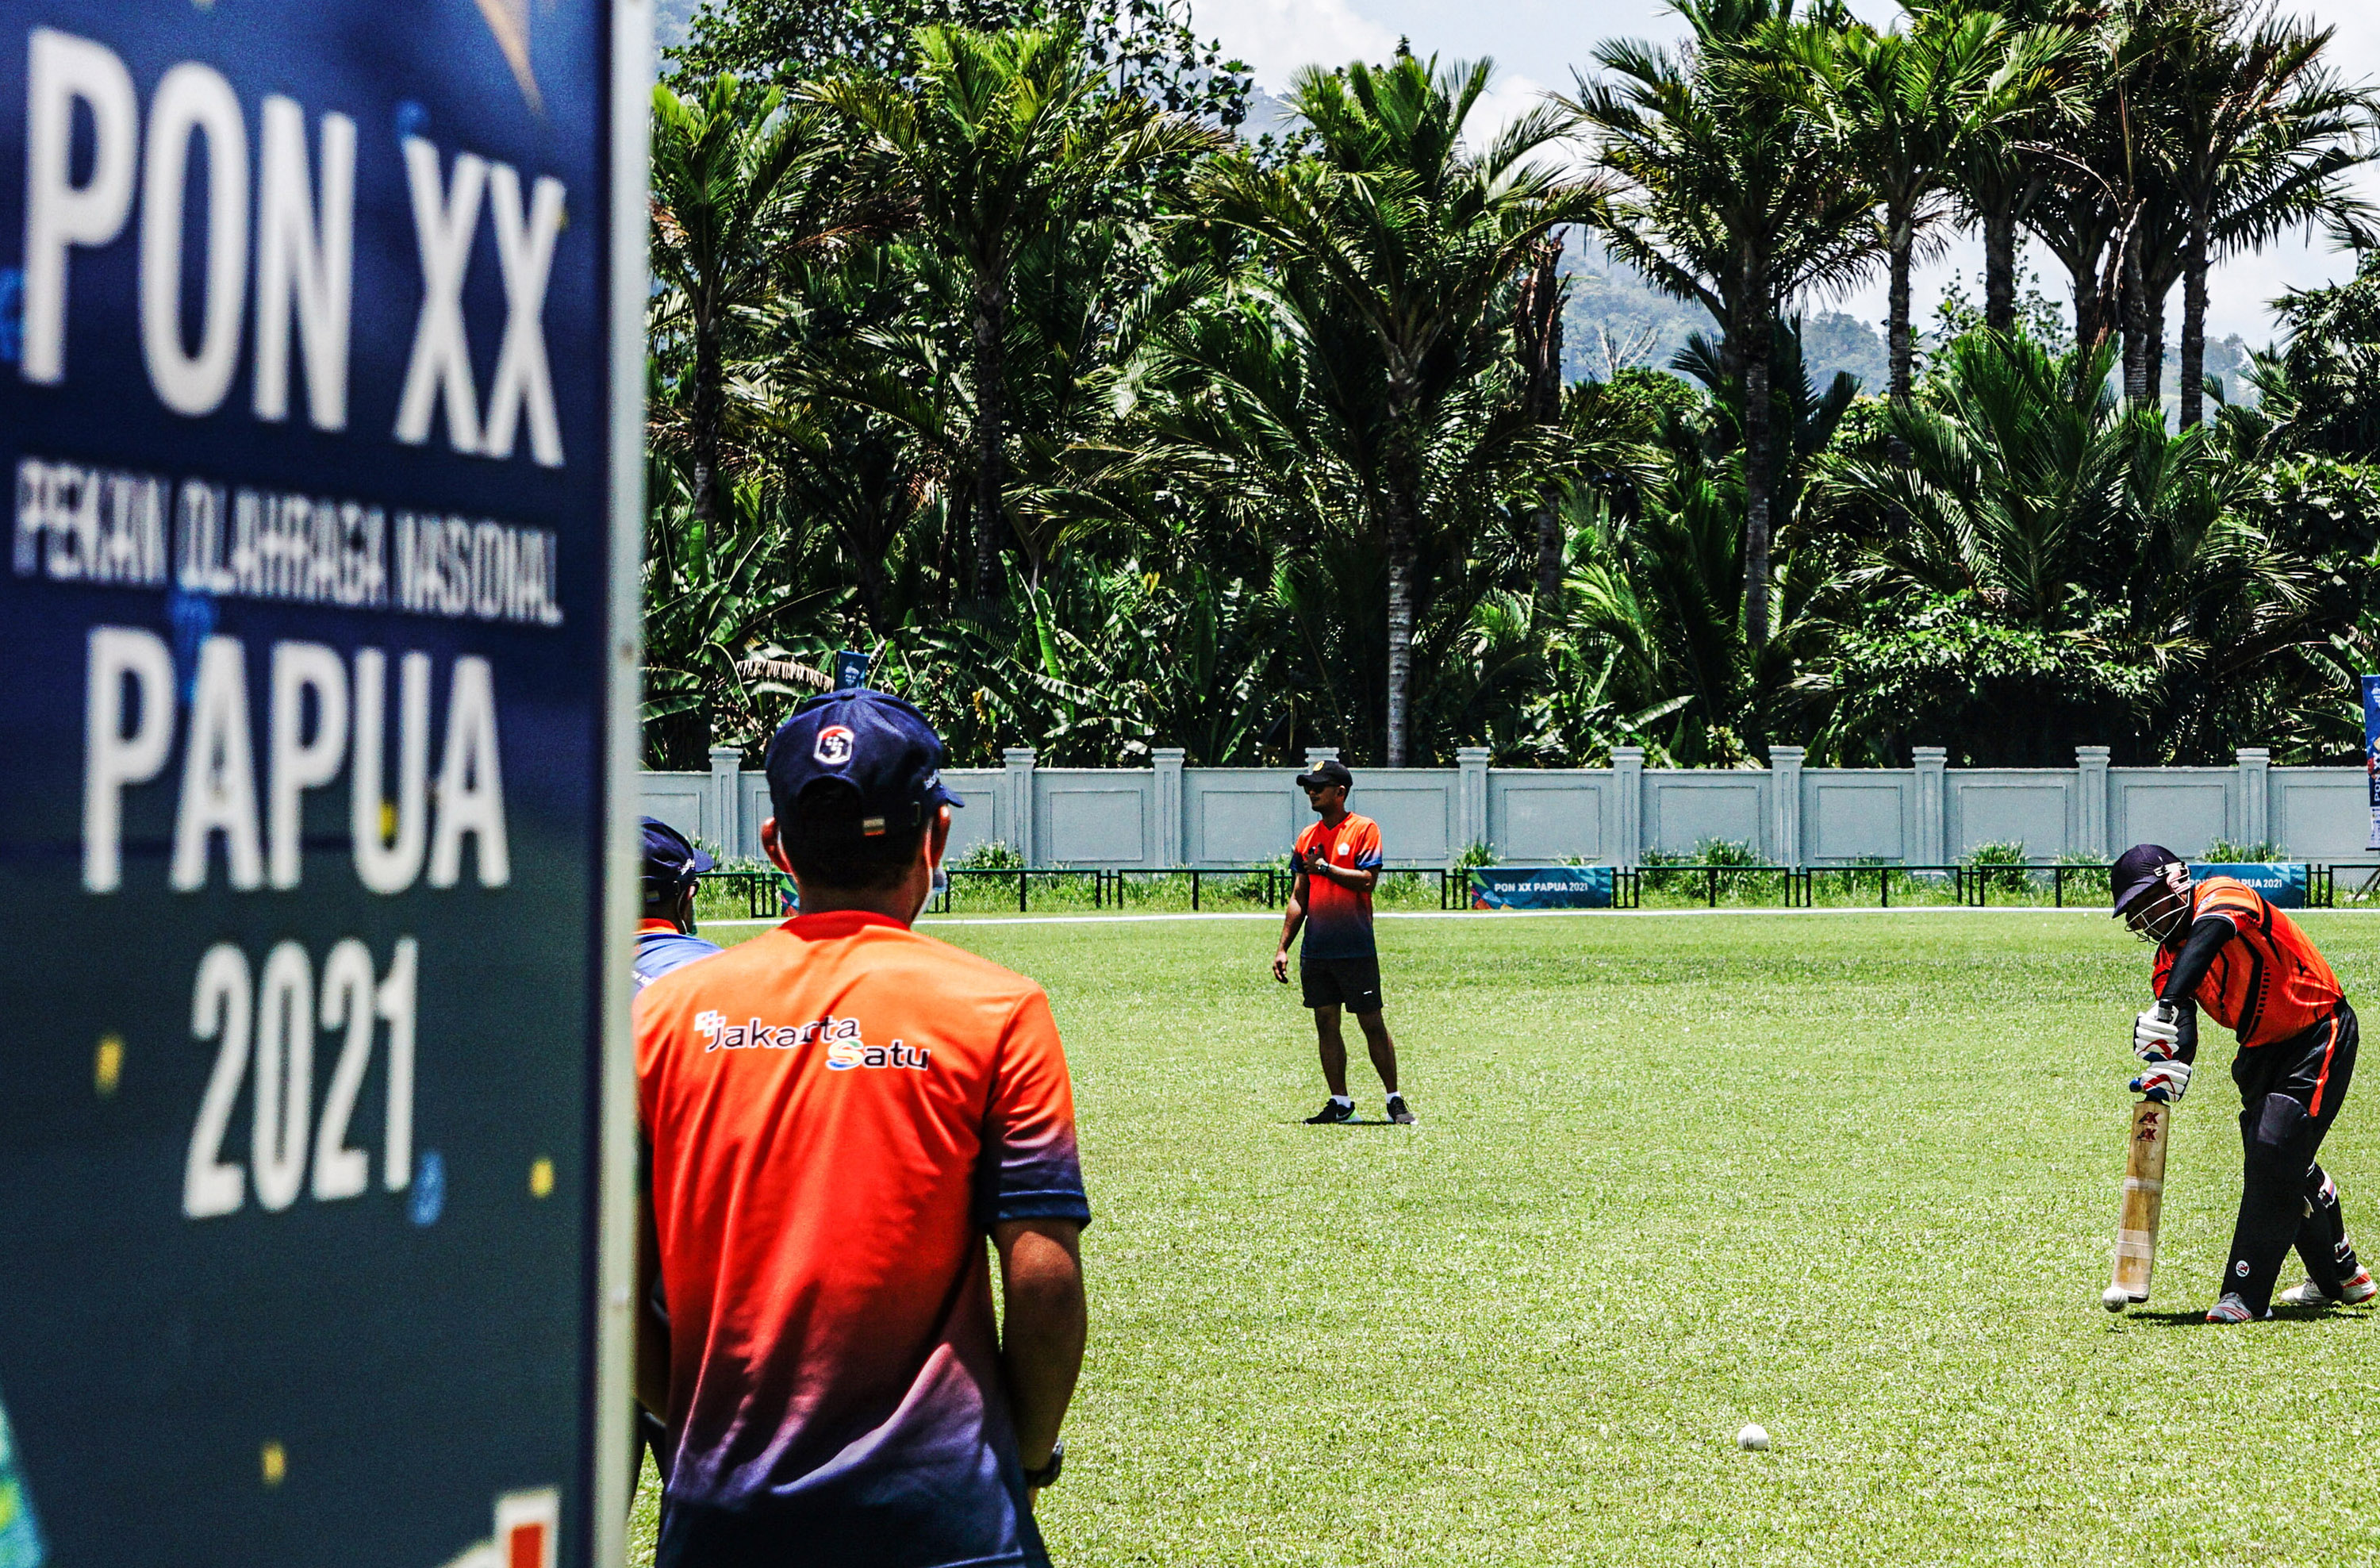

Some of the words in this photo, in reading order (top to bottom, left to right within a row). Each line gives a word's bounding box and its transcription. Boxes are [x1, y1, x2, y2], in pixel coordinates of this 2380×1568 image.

[22, 27, 356, 431] PON
[395, 137, 566, 467] XX
[14, 458, 168, 584] PEKAN
[176, 480, 387, 605] OLAHRAGA
[395, 513, 562, 625] NASIONAL
[83, 625, 510, 894] PAPUA
[1495, 883, 1516, 892] PON
[1518, 882, 1532, 892] XX
[1534, 882, 1568, 891] PAPUA
[1569, 882, 1588, 891] 2021
[2263, 878, 2283, 888] 2021
[183, 938, 417, 1219] 2021
[826, 1039, 931, 1070] Satu
